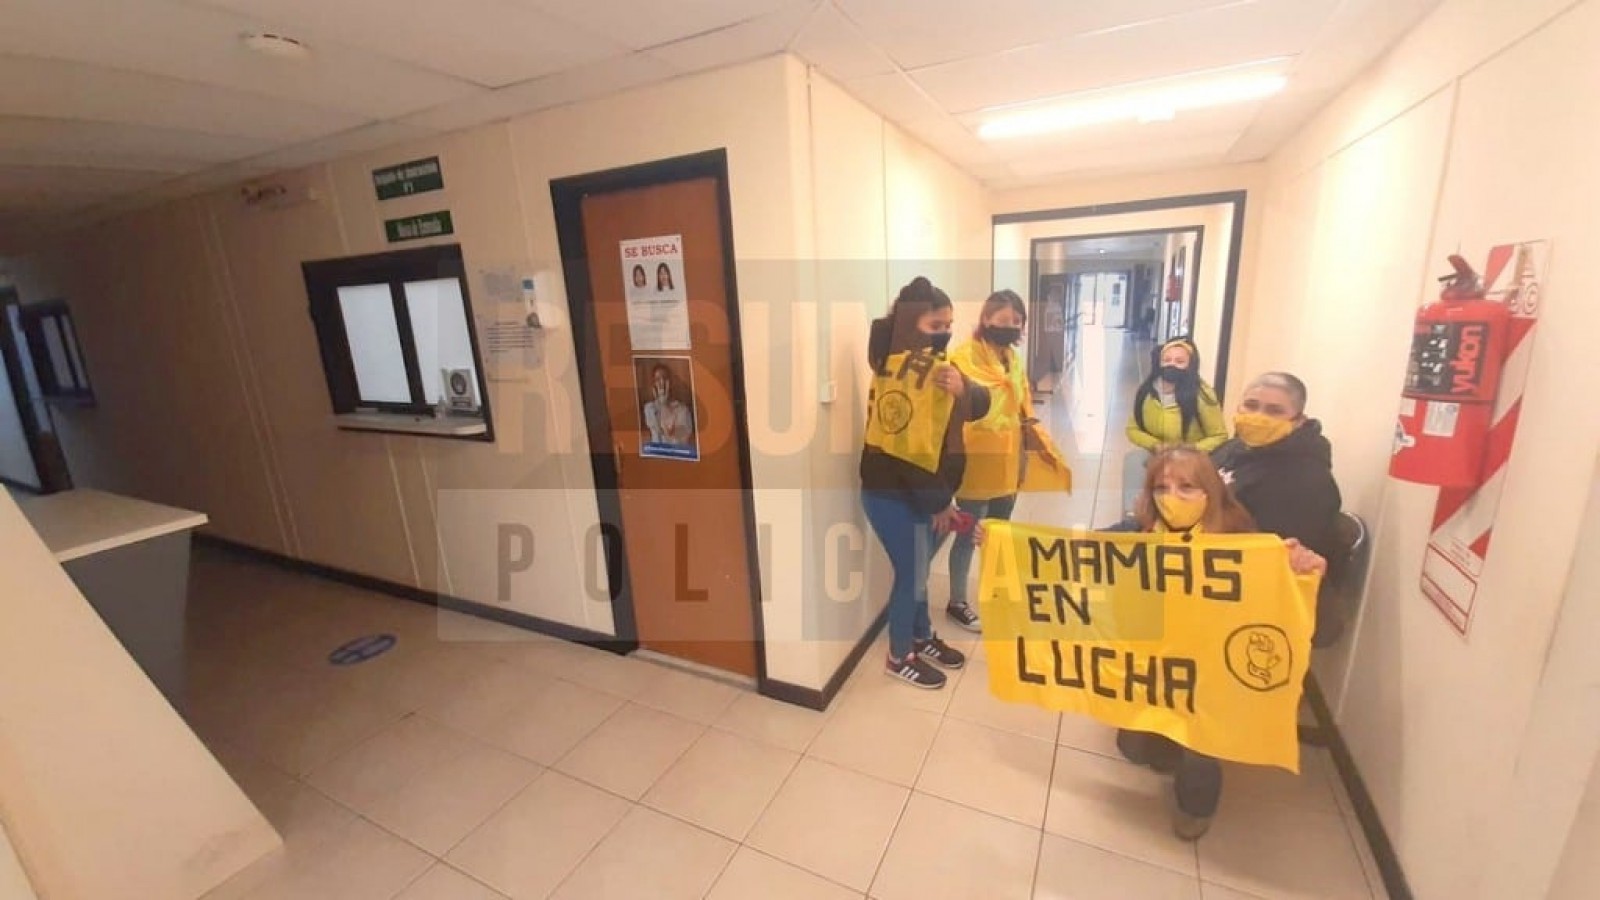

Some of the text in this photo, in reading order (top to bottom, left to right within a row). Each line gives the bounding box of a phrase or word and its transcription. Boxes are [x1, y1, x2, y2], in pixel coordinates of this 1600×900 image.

[624, 244, 678, 258] SE BUSCA
[1450, 325, 1483, 393] yukon
[1026, 584, 1091, 625] EN
[1017, 636, 1196, 714] LUCHA
